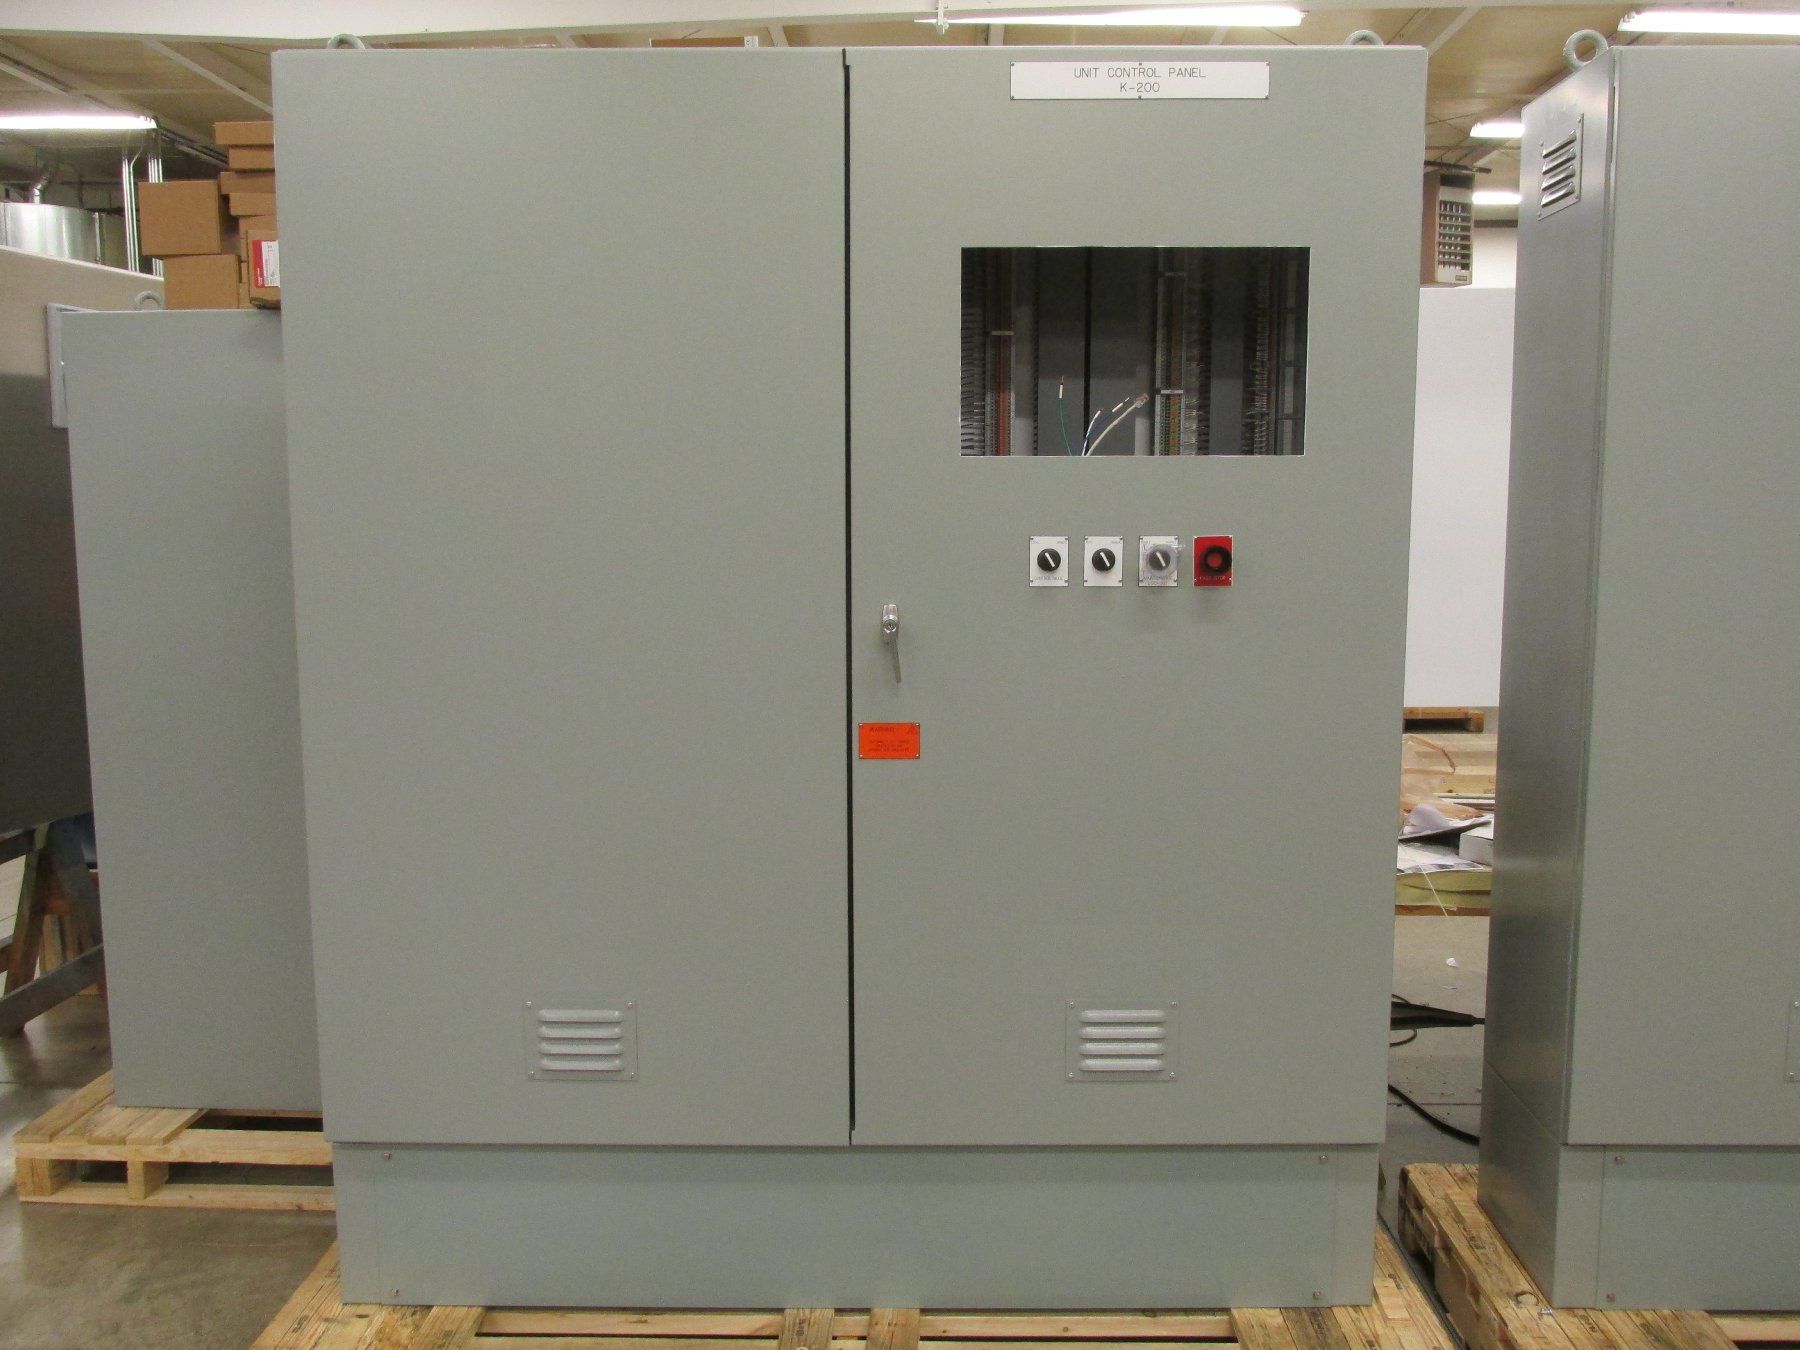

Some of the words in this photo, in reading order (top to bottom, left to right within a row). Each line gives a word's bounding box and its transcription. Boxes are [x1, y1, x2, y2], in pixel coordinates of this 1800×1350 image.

[1074, 67, 1099, 78] UNIT
[1107, 67, 1161, 78] CONTROL
[1168, 67, 1206, 78] PANEL
[1119, 82, 1160, 93] K-200
